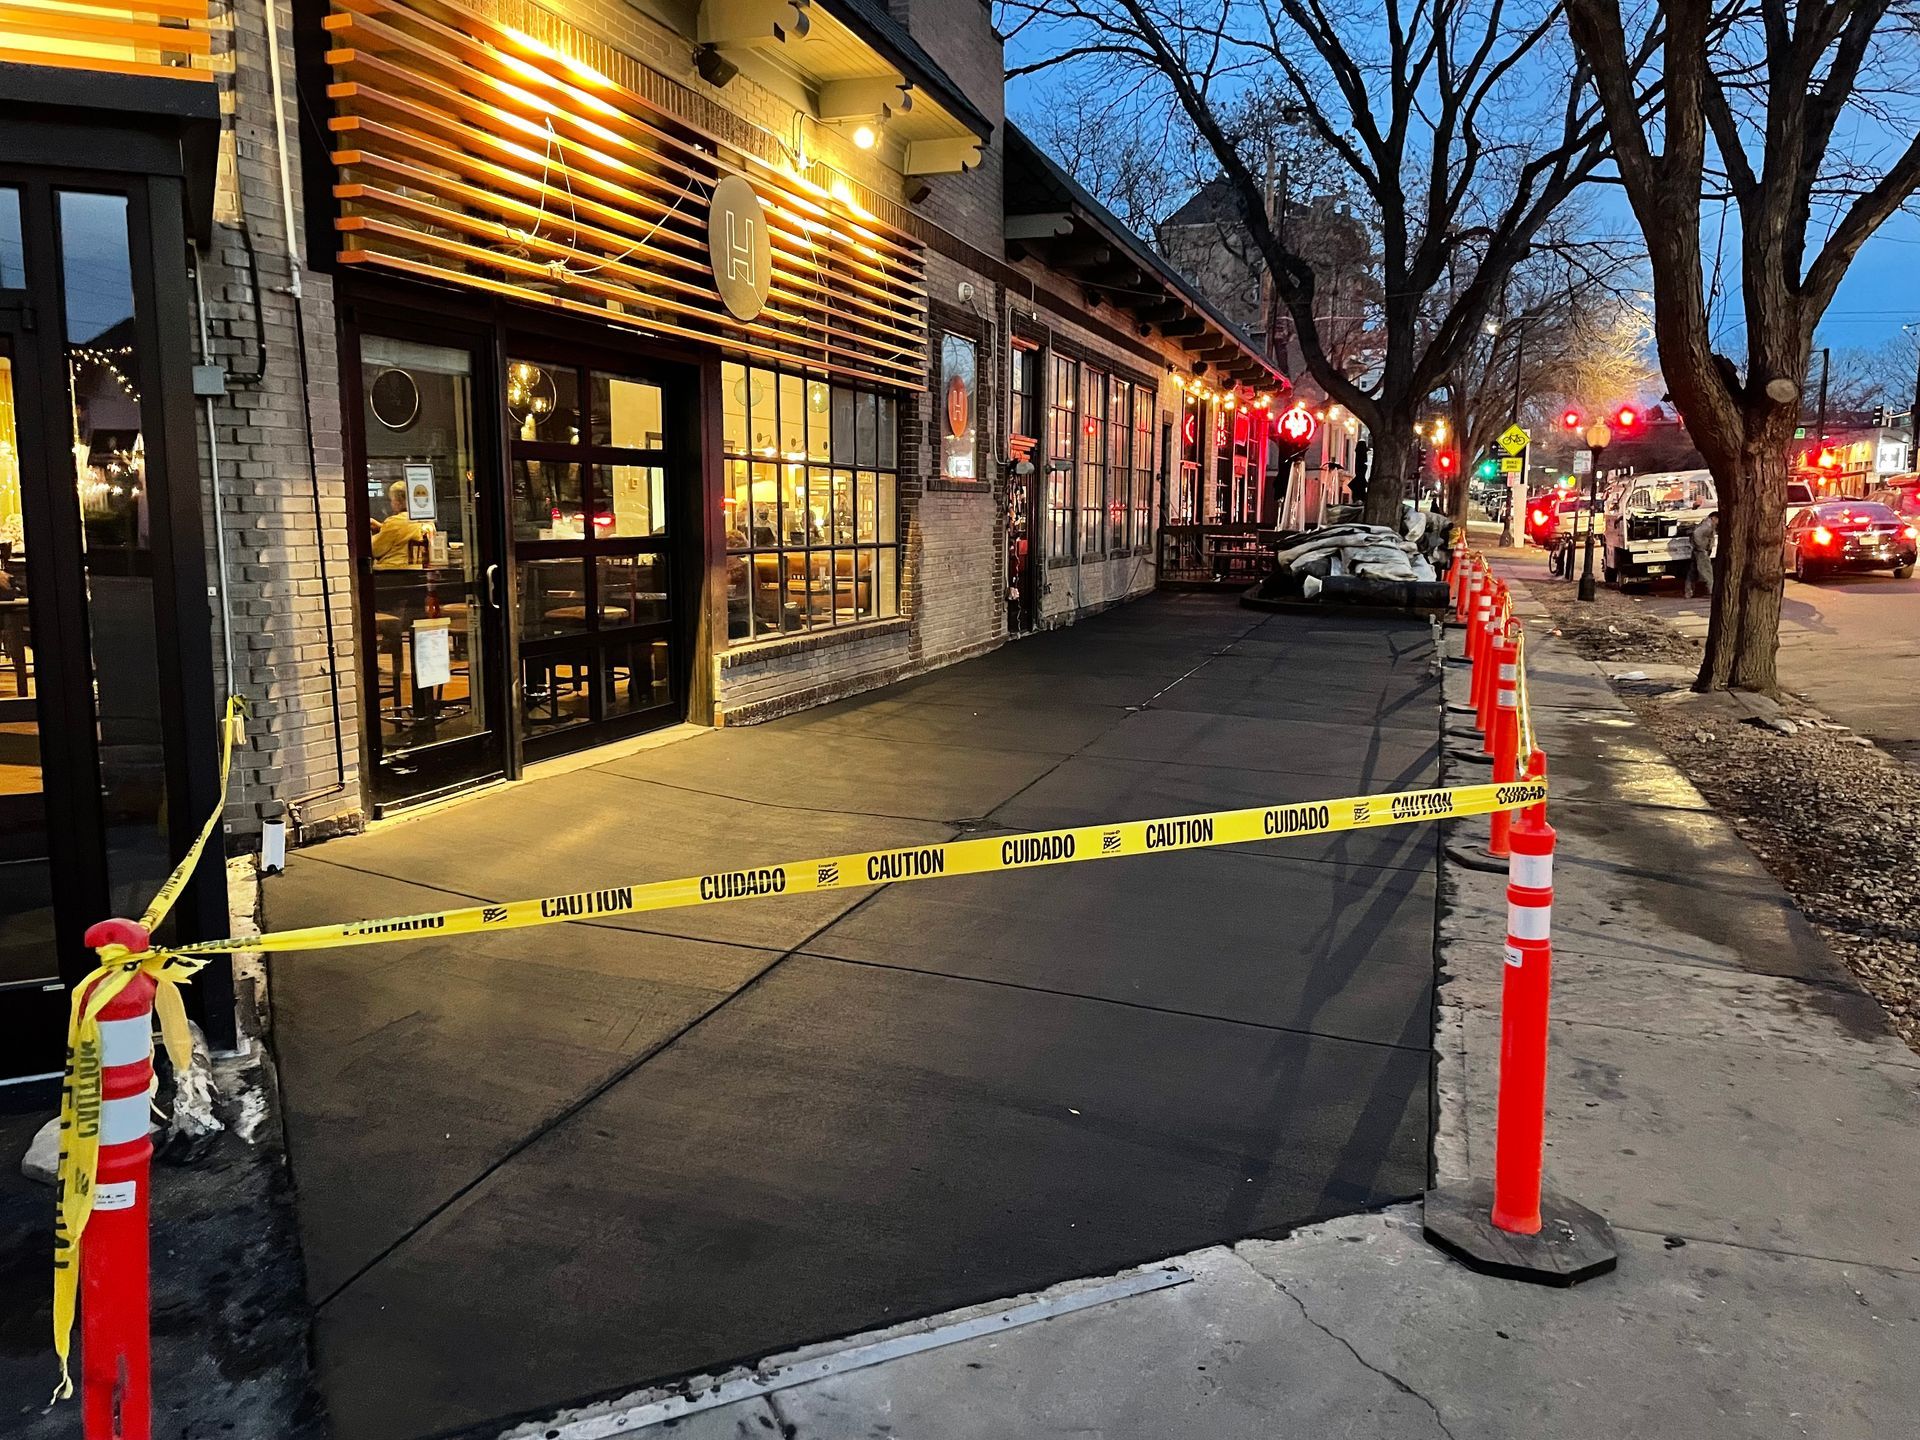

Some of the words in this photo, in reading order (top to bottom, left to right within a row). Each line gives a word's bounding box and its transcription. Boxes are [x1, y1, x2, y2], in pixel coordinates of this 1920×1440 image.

[725, 209, 755, 287] H
[952, 390, 964, 422] H
[541, 887, 633, 918] CAUTION
[700, 867, 786, 901] CUIDADO
[868, 845, 944, 881] CAUTION
[1001, 833, 1075, 865] CUIDADO
[1145, 818, 1213, 849] CAUTION
[1264, 805, 1330, 835] CUIDADO
[1391, 791, 1453, 820] CAUTION
[1495, 785, 1546, 805] CUIDAD
